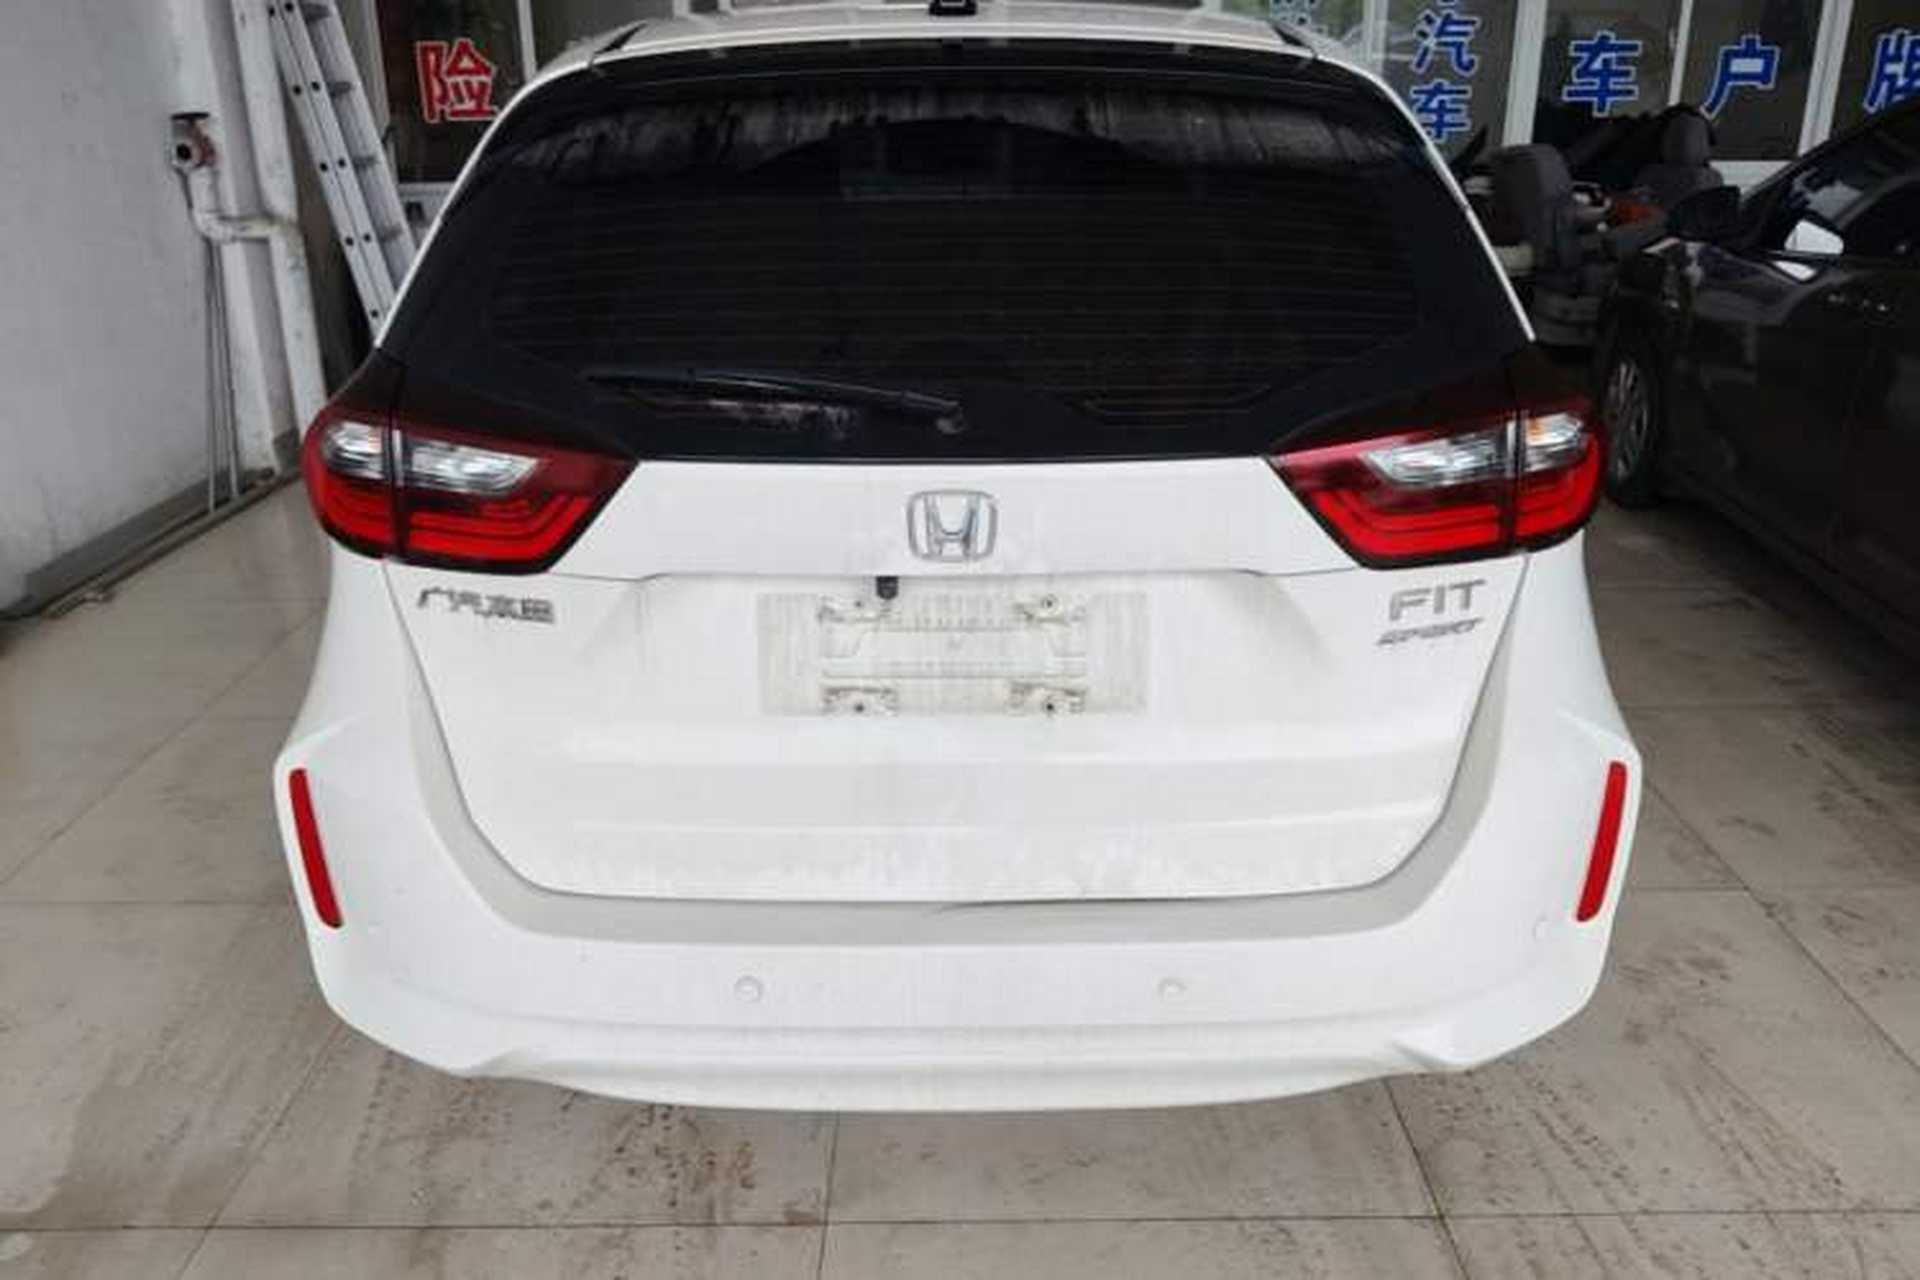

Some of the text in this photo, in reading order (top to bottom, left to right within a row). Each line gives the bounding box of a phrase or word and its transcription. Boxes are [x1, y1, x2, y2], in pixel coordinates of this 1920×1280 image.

[415, 38, 500, 123] 险
[1410, 0, 1480, 142] 汽车
[1563, 31, 1642, 117] 车
[1700, 34, 1780, 119] 户
[1389, 579, 1486, 621] FIT
